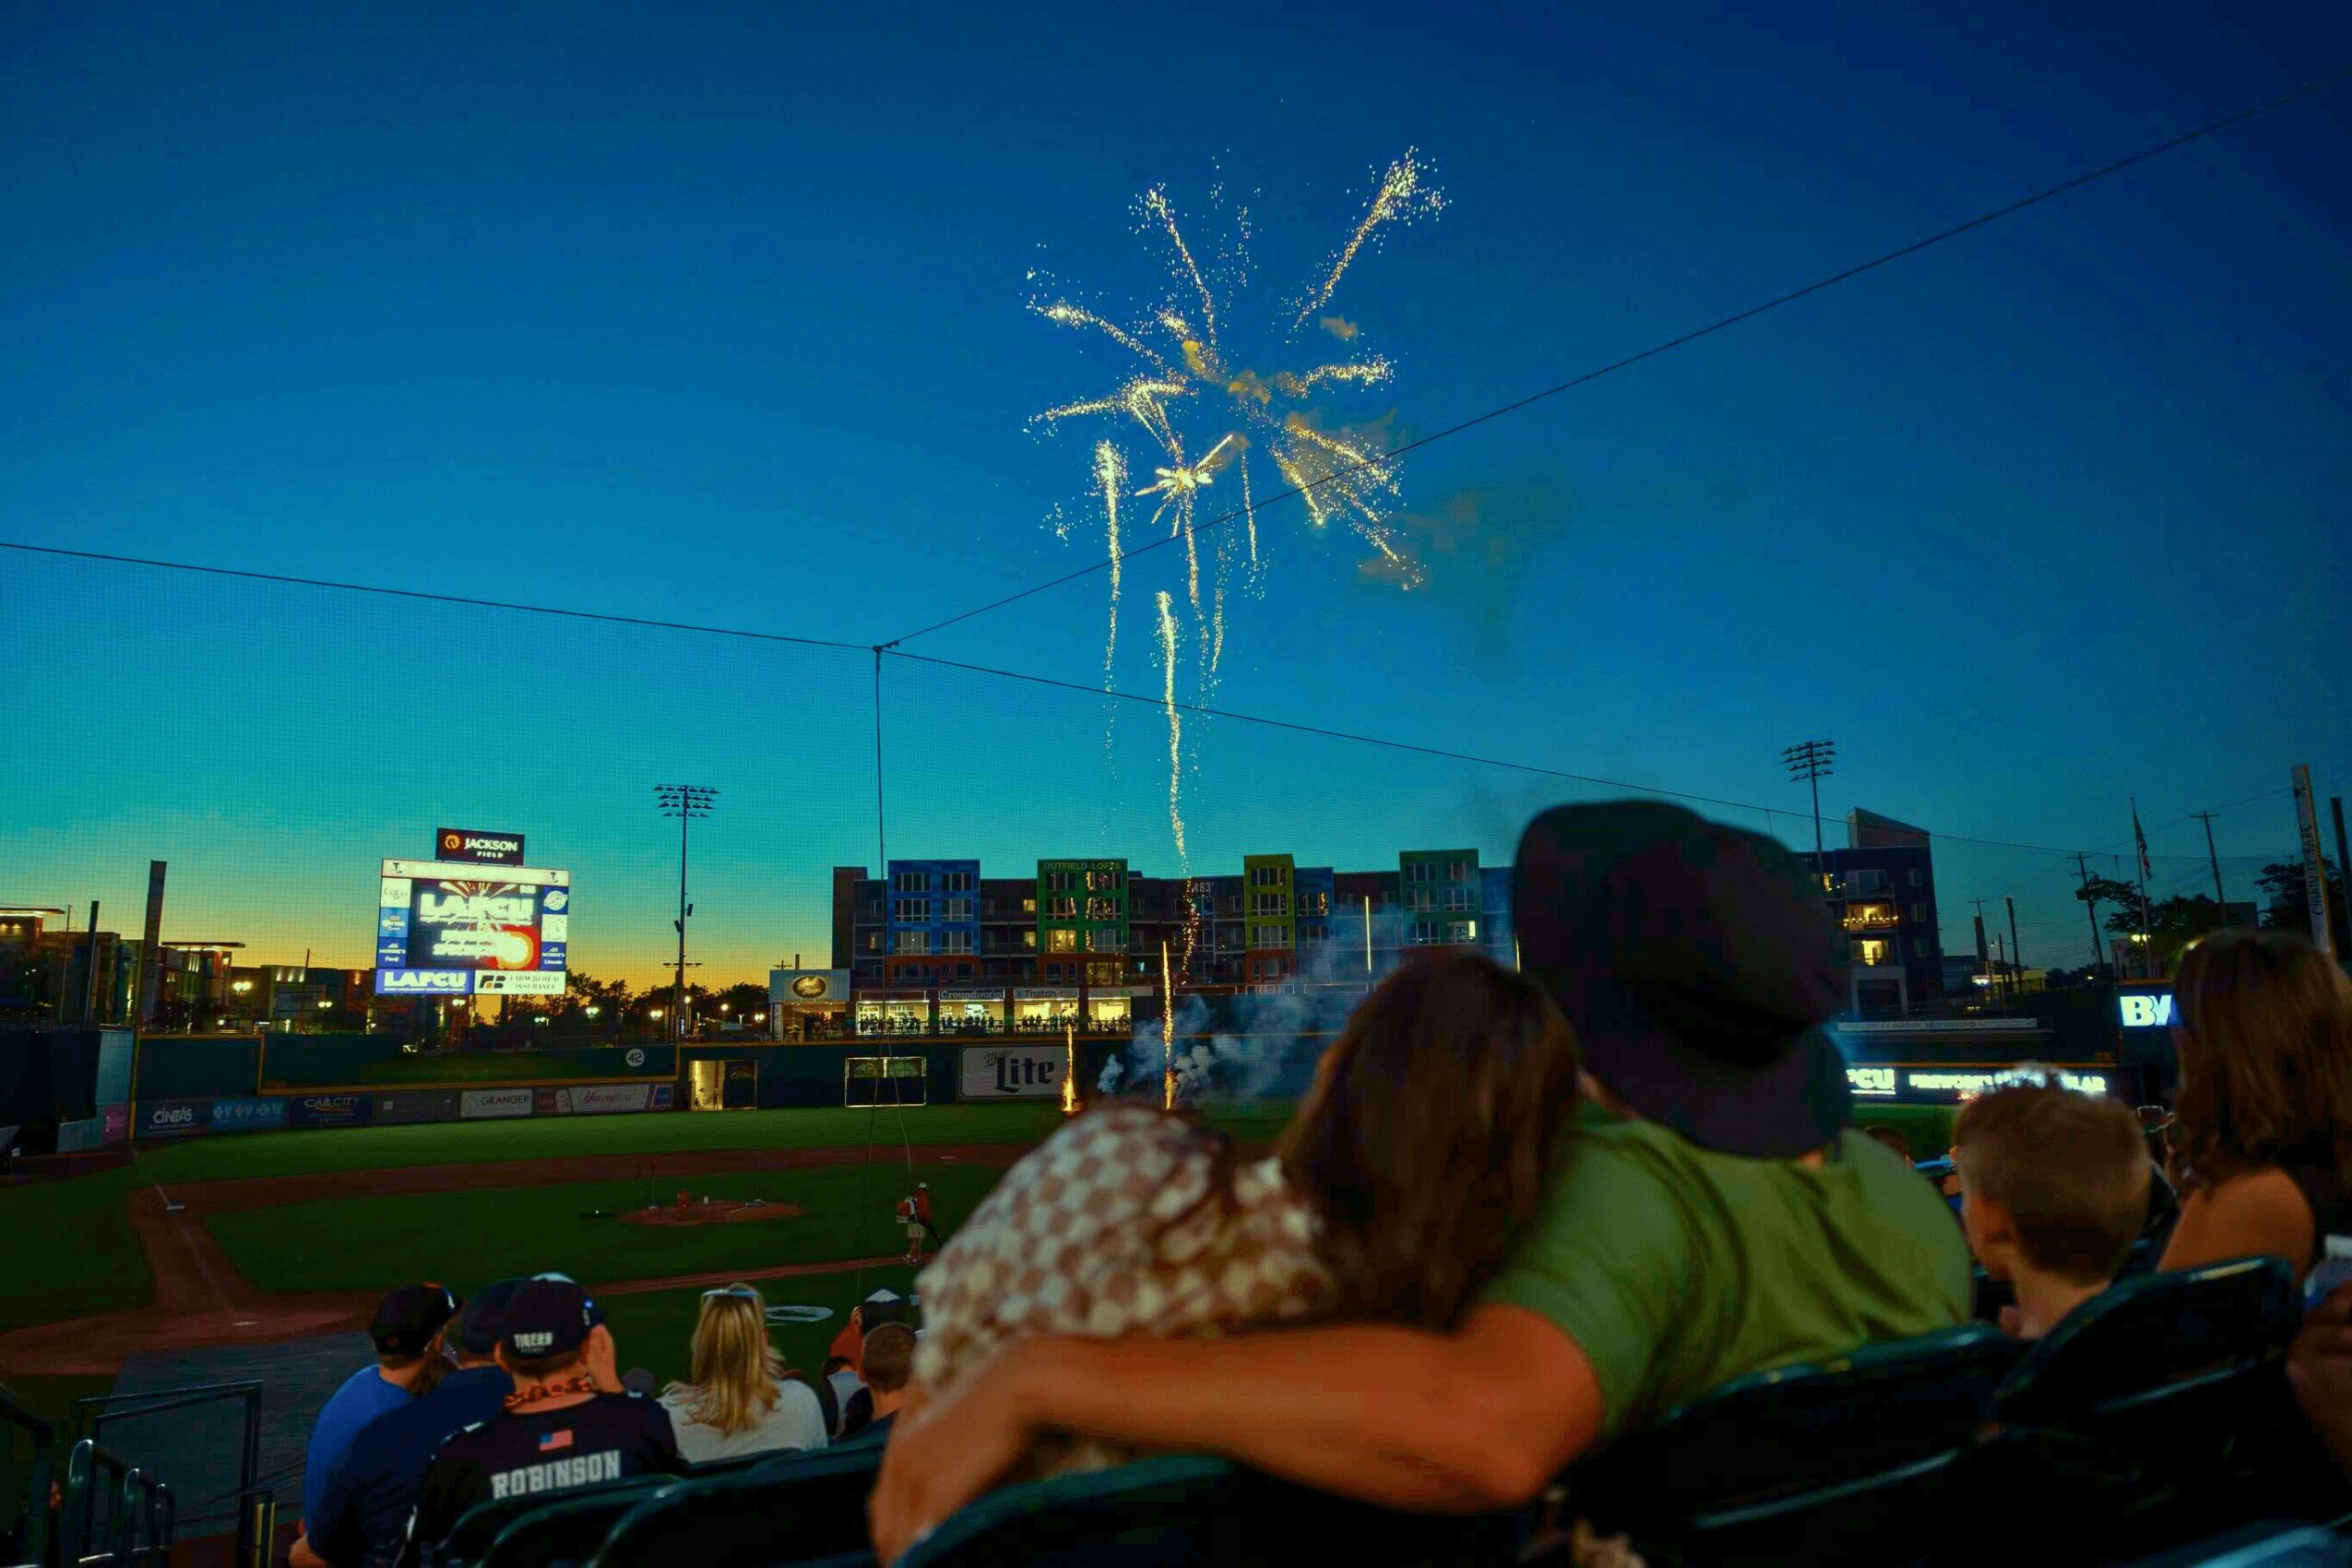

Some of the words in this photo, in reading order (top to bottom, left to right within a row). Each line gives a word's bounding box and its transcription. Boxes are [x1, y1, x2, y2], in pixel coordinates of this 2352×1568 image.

[464, 837, 518, 851] JACKSON
[1044, 861, 1087, 870] OUTFIELD
[1091, 861, 1122, 871] LOFTS
[421, 894, 533, 919] LAFCU
[384, 971, 467, 988] LAFCU
[941, 989, 1004, 999] Groundworks
[1026, 989, 1056, 998] Thatch
[628, 1051, 643, 1063] 42
[993, 1057, 1054, 1093] Lite
[481, 1094, 529, 1105] GRANGER
[491, 1449, 622, 1500] ROBINSON
